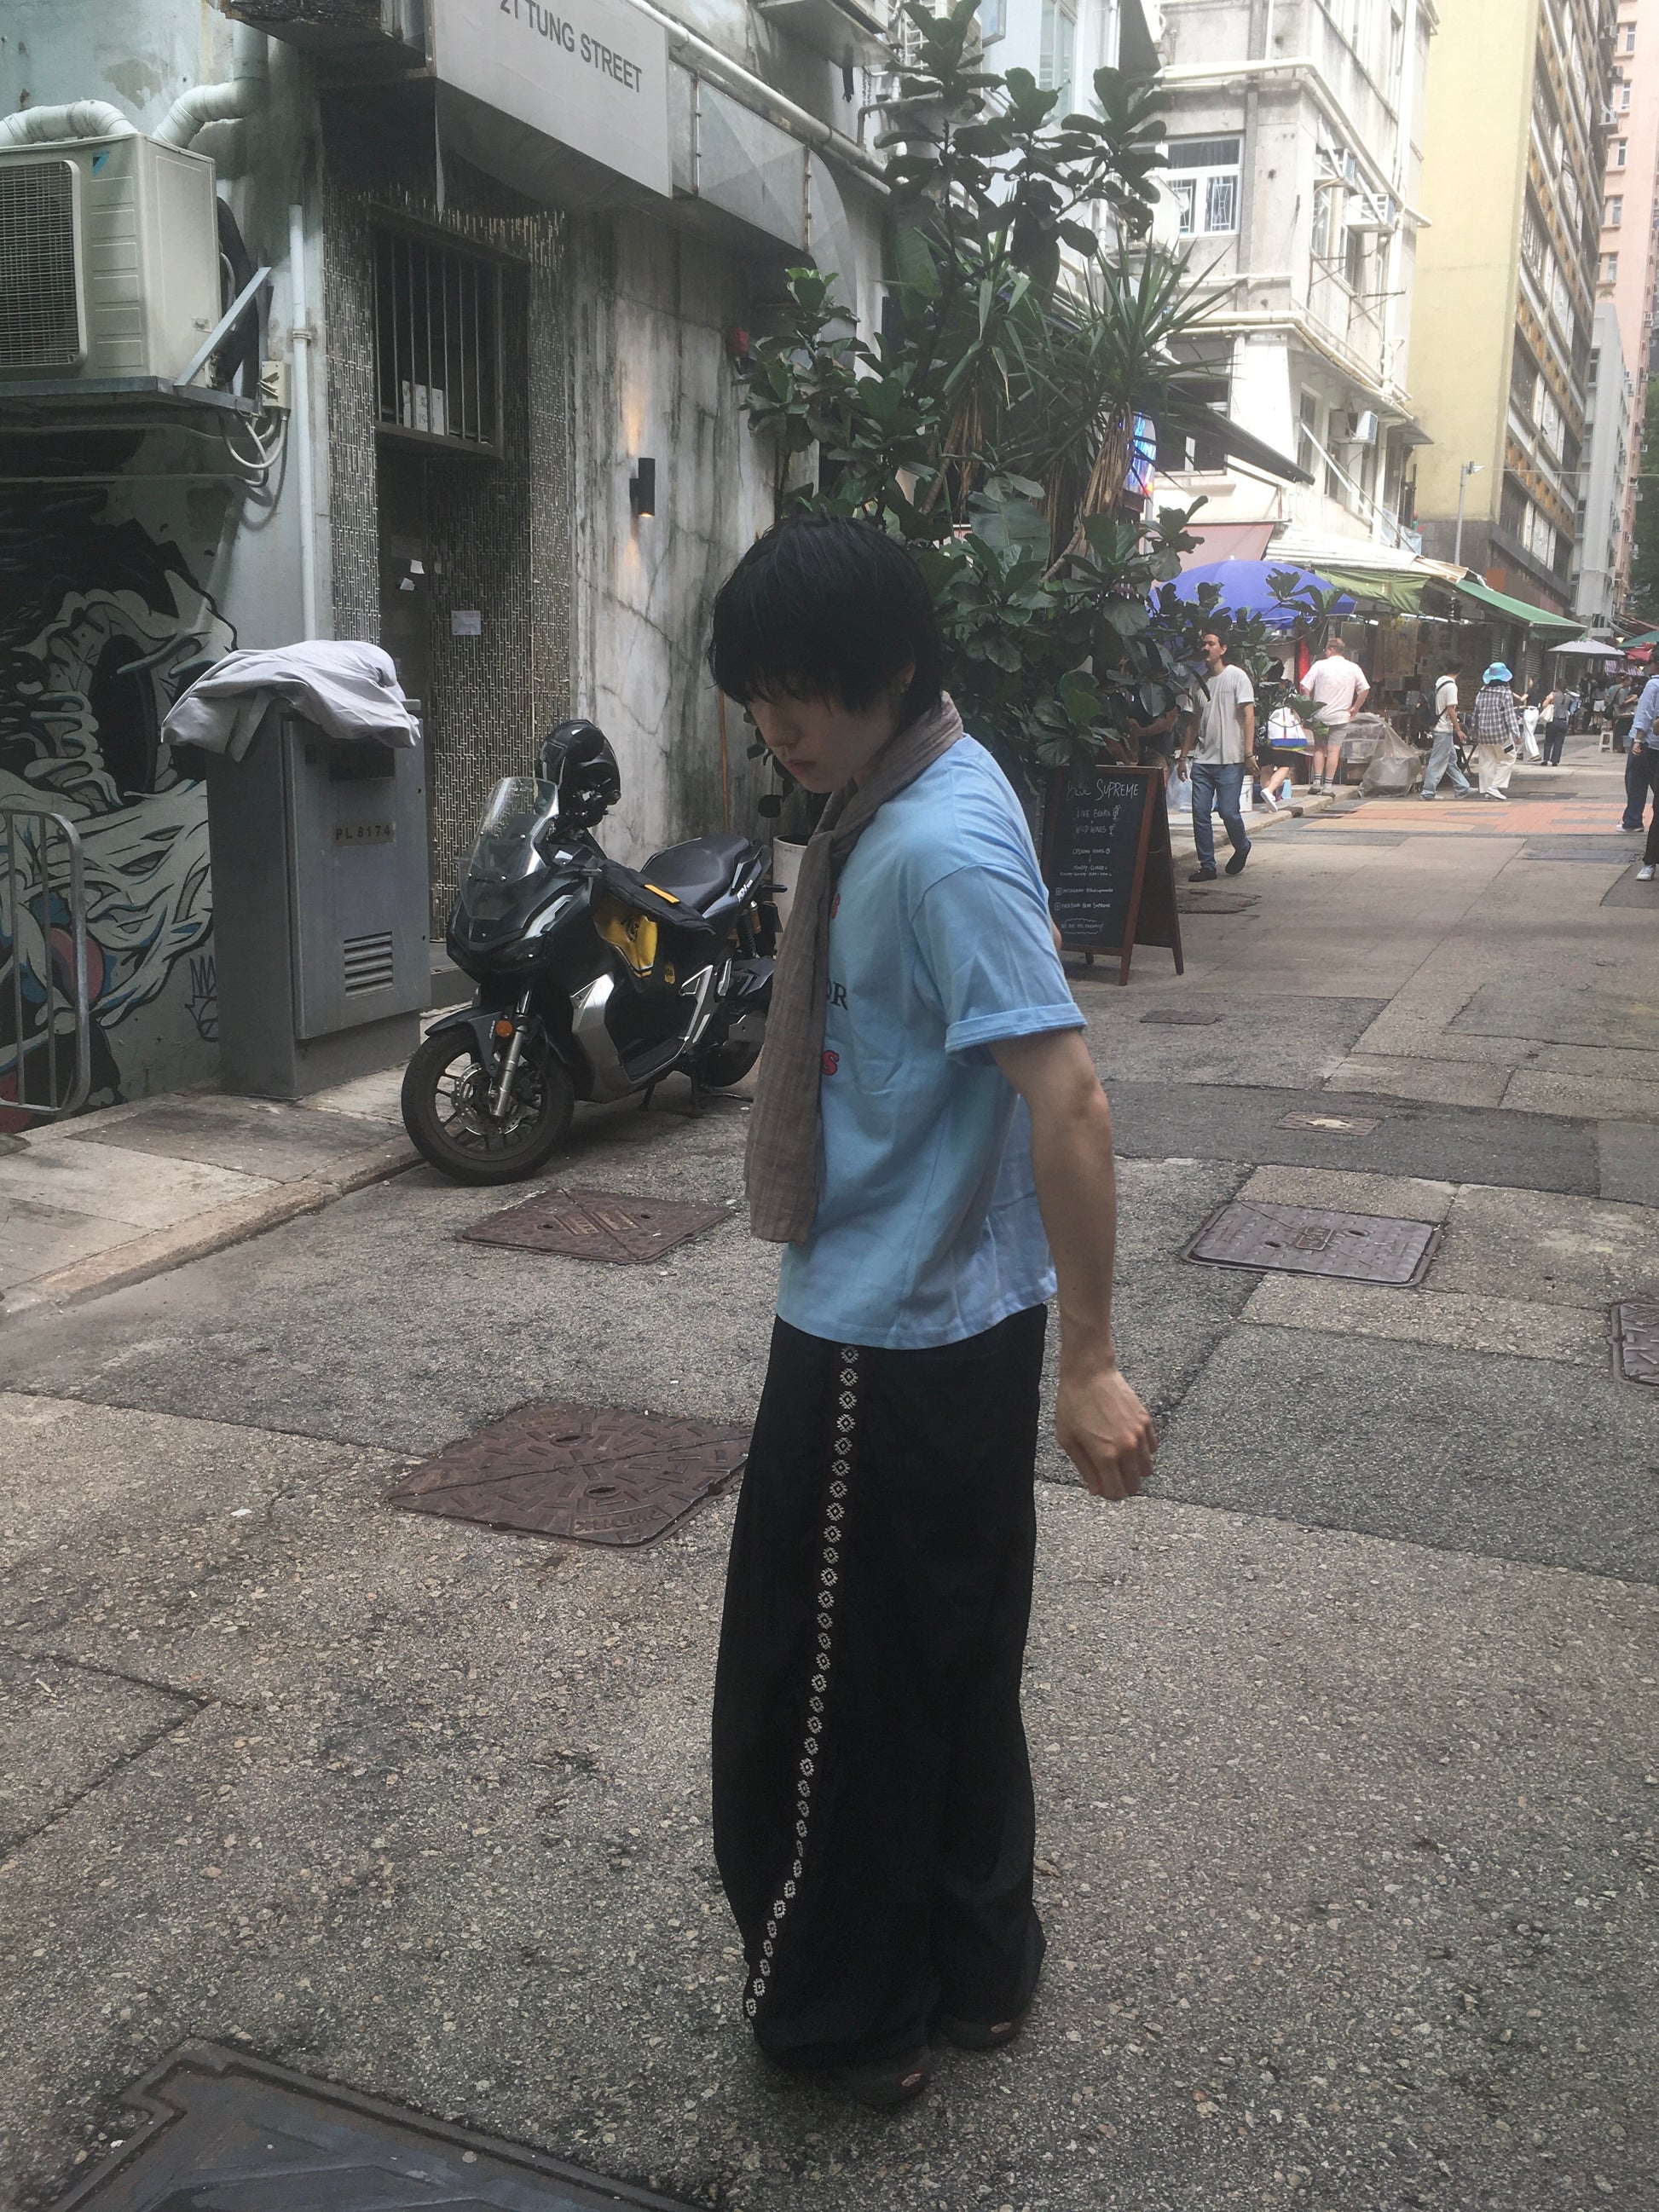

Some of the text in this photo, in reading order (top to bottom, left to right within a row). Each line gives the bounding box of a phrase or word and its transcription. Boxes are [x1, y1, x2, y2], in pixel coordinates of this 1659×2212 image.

[524, 0, 575, 53] TUNG
[581, 33, 643, 93] STREET
[1095, 778, 1139, 801] SUPREME
[1077, 809, 1090, 818] LIVE
[335, 825, 391, 840] PL 8174
